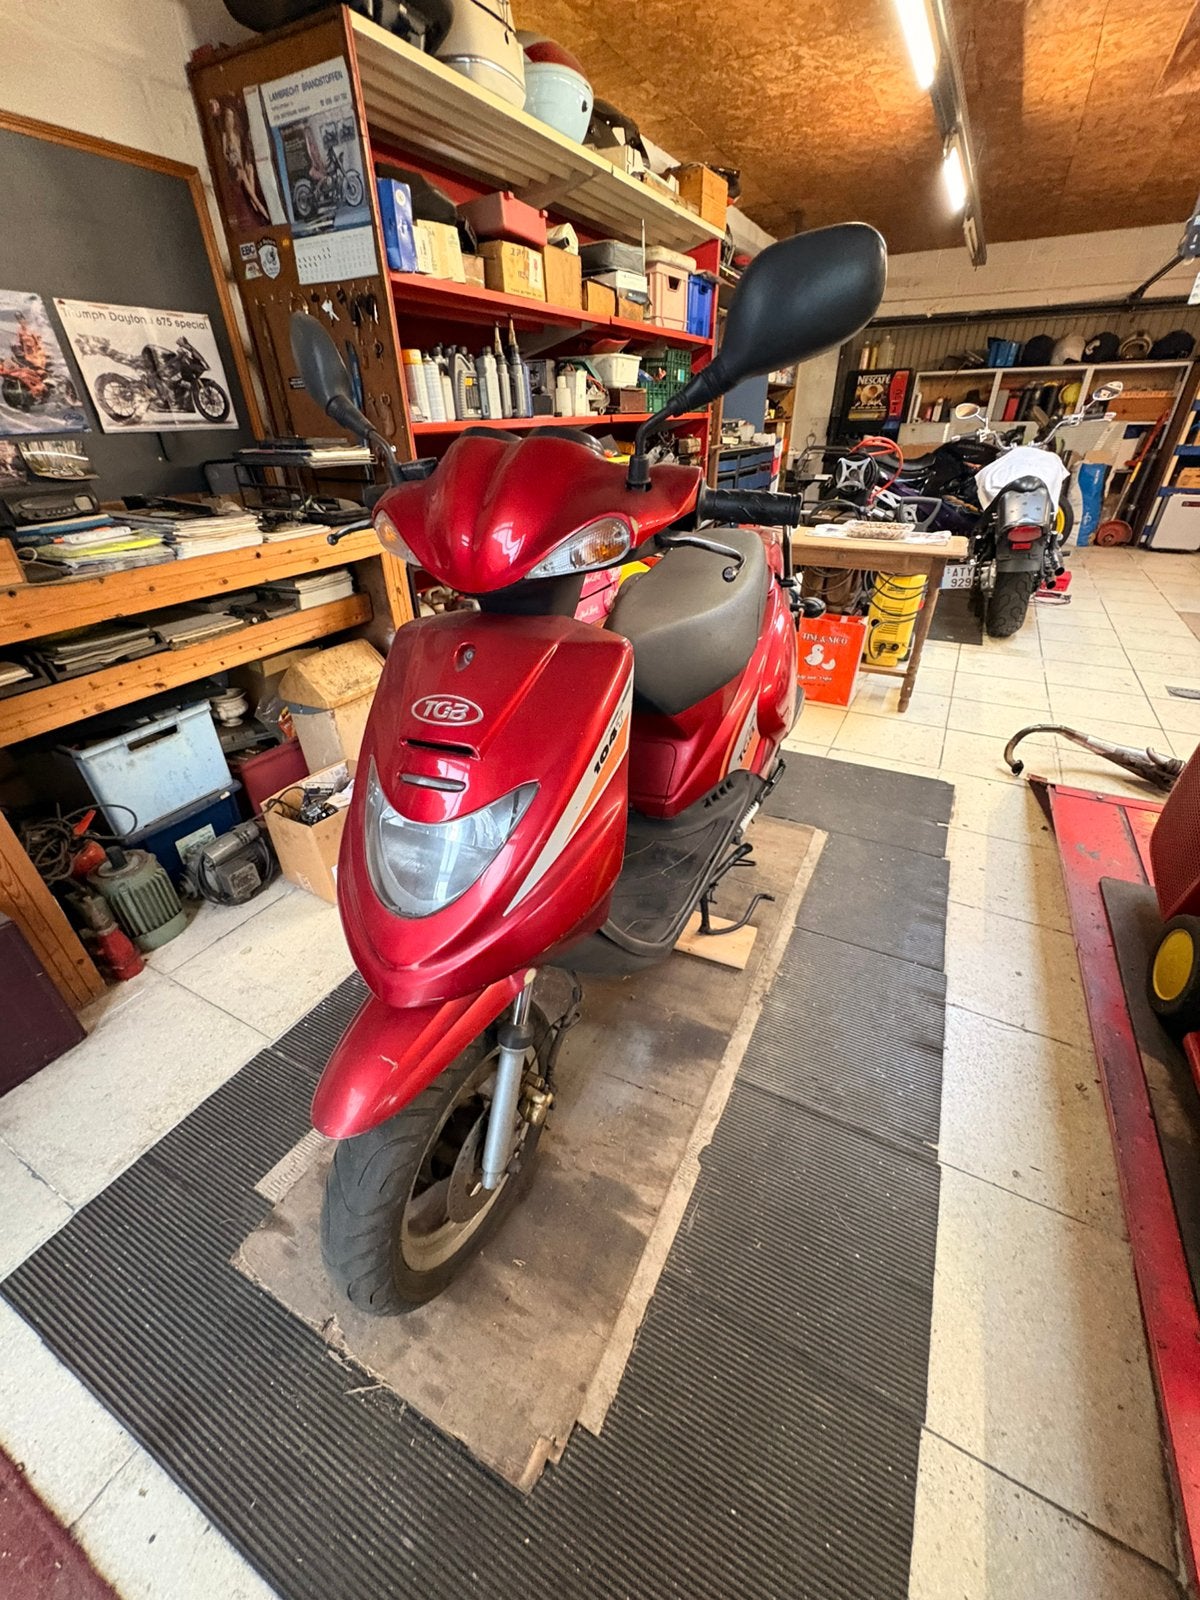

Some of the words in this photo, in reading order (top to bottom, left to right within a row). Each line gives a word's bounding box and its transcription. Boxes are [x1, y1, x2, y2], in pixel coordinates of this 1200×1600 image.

[240, 244, 255, 256] EBC
[156, 316, 173, 327] 675
[174, 319, 209, 331] special
[952, 567, 973, 577] ATY
[951, 577, 972, 587] 929
[423, 700, 469, 721] TGB
